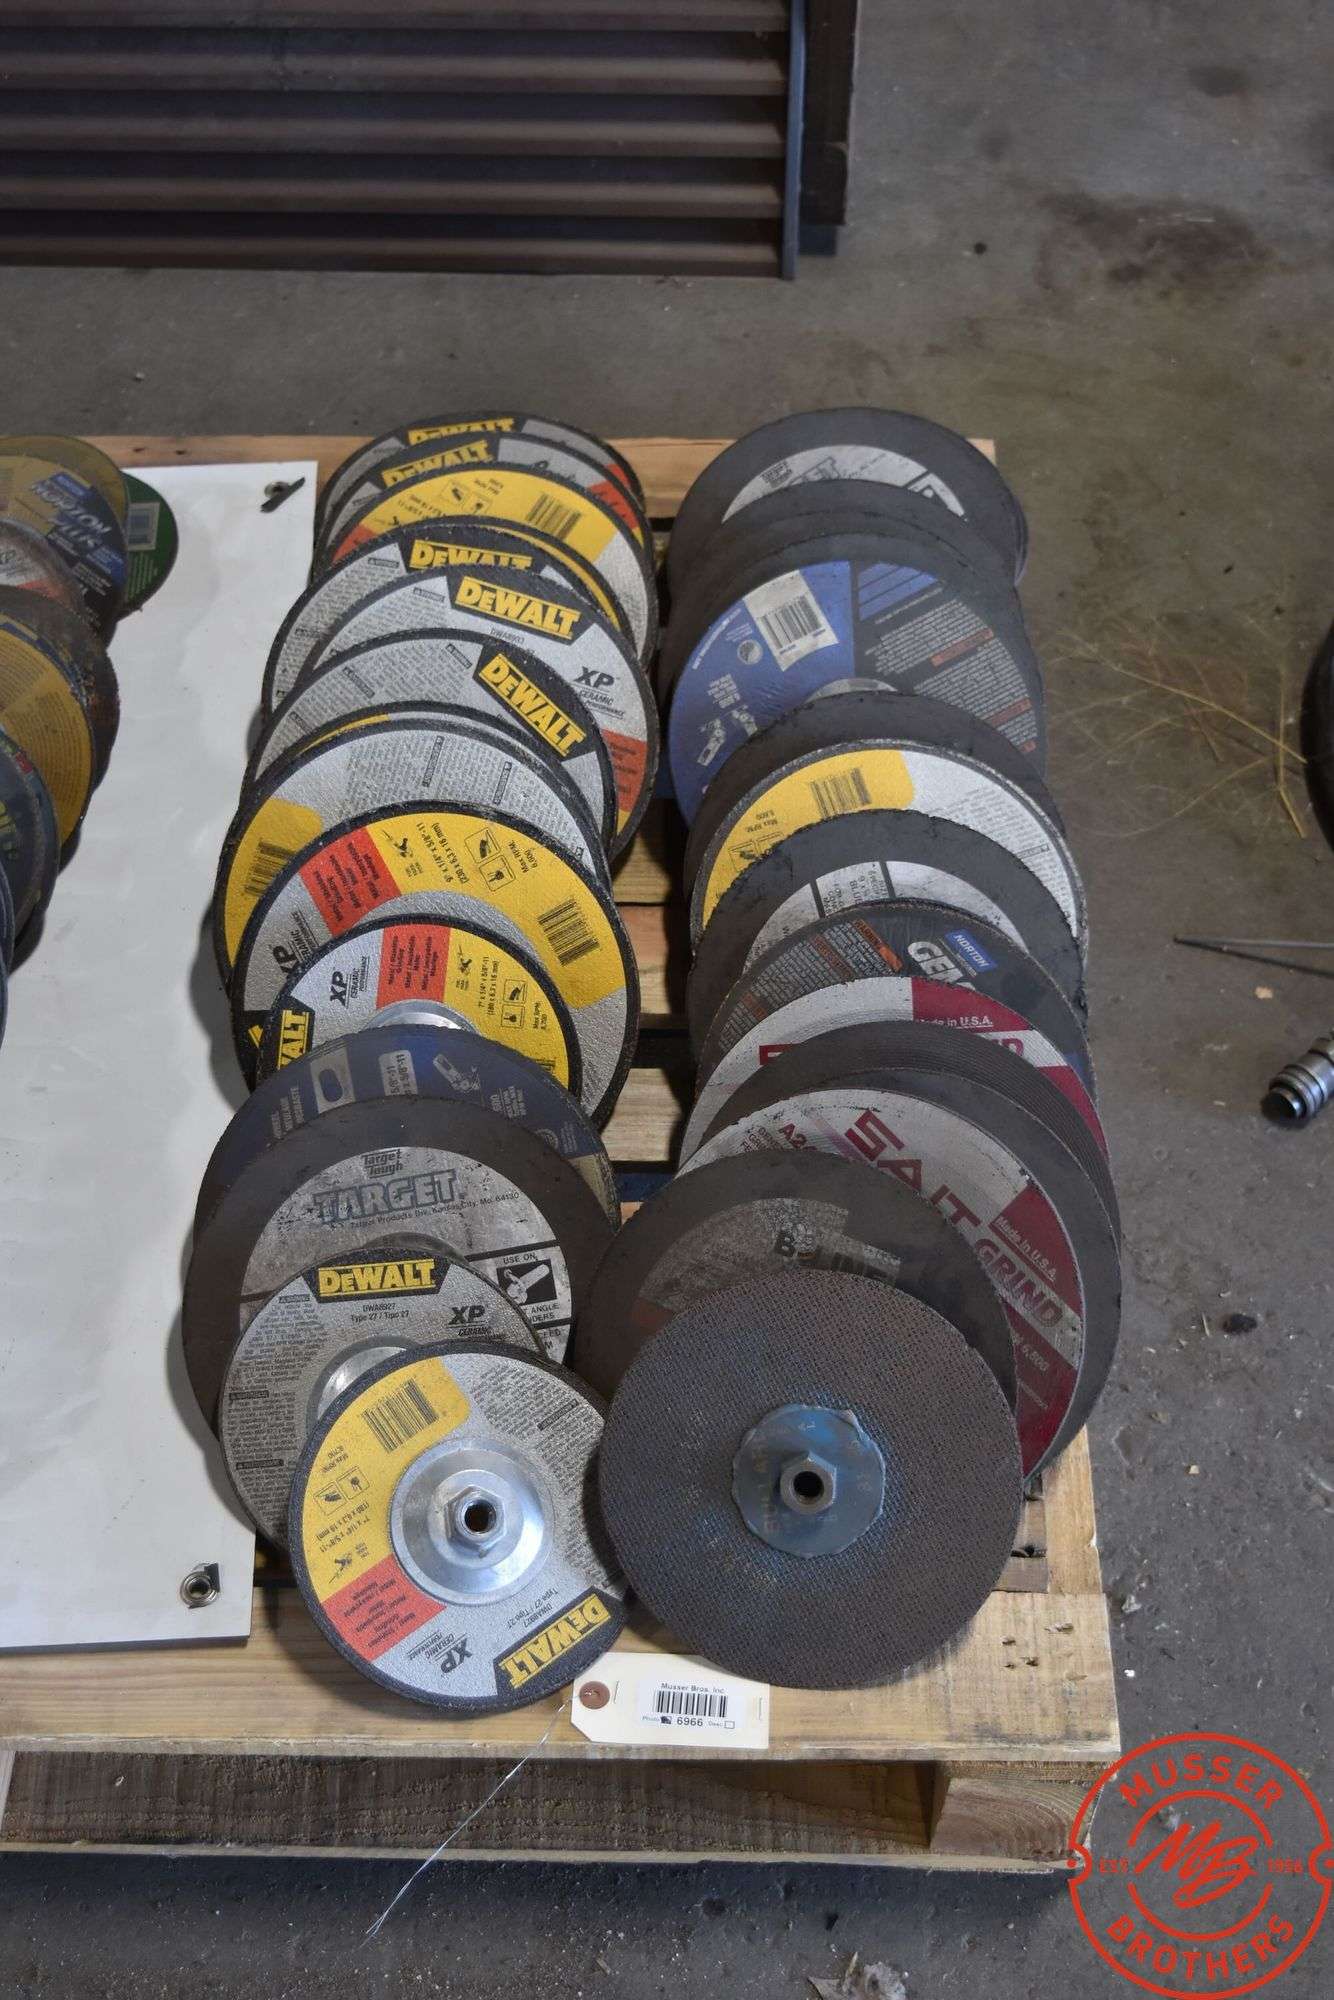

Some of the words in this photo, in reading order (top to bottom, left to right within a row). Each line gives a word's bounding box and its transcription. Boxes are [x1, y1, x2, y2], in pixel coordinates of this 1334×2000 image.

[382, 440, 493, 487] DEWALT
[455, 576, 581, 640] DEWALT
[573, 666, 616, 689] XP
[478, 653, 587, 757] DEWALT
[954, 934, 990, 968] NORTON
[330, 971, 348, 1006] XP
[960, 1016, 993, 1027] U.S.A.
[362, 1149, 402, 1166] Target
[366, 1162, 404, 1177] Tough
[313, 1168, 457, 1224] TARGET
[503, 1256, 520, 1265] USE
[319, 1261, 434, 1294] DEWALT
[449, 1305, 485, 1325] XP
[531, 1303, 560, 1315] ANGLE
[500, 1596, 610, 1686] DEWALT
[440, 1638, 473, 1674] XP
[660, 1683, 688, 1691] Musser
[676, 1716, 704, 1727] 6966
